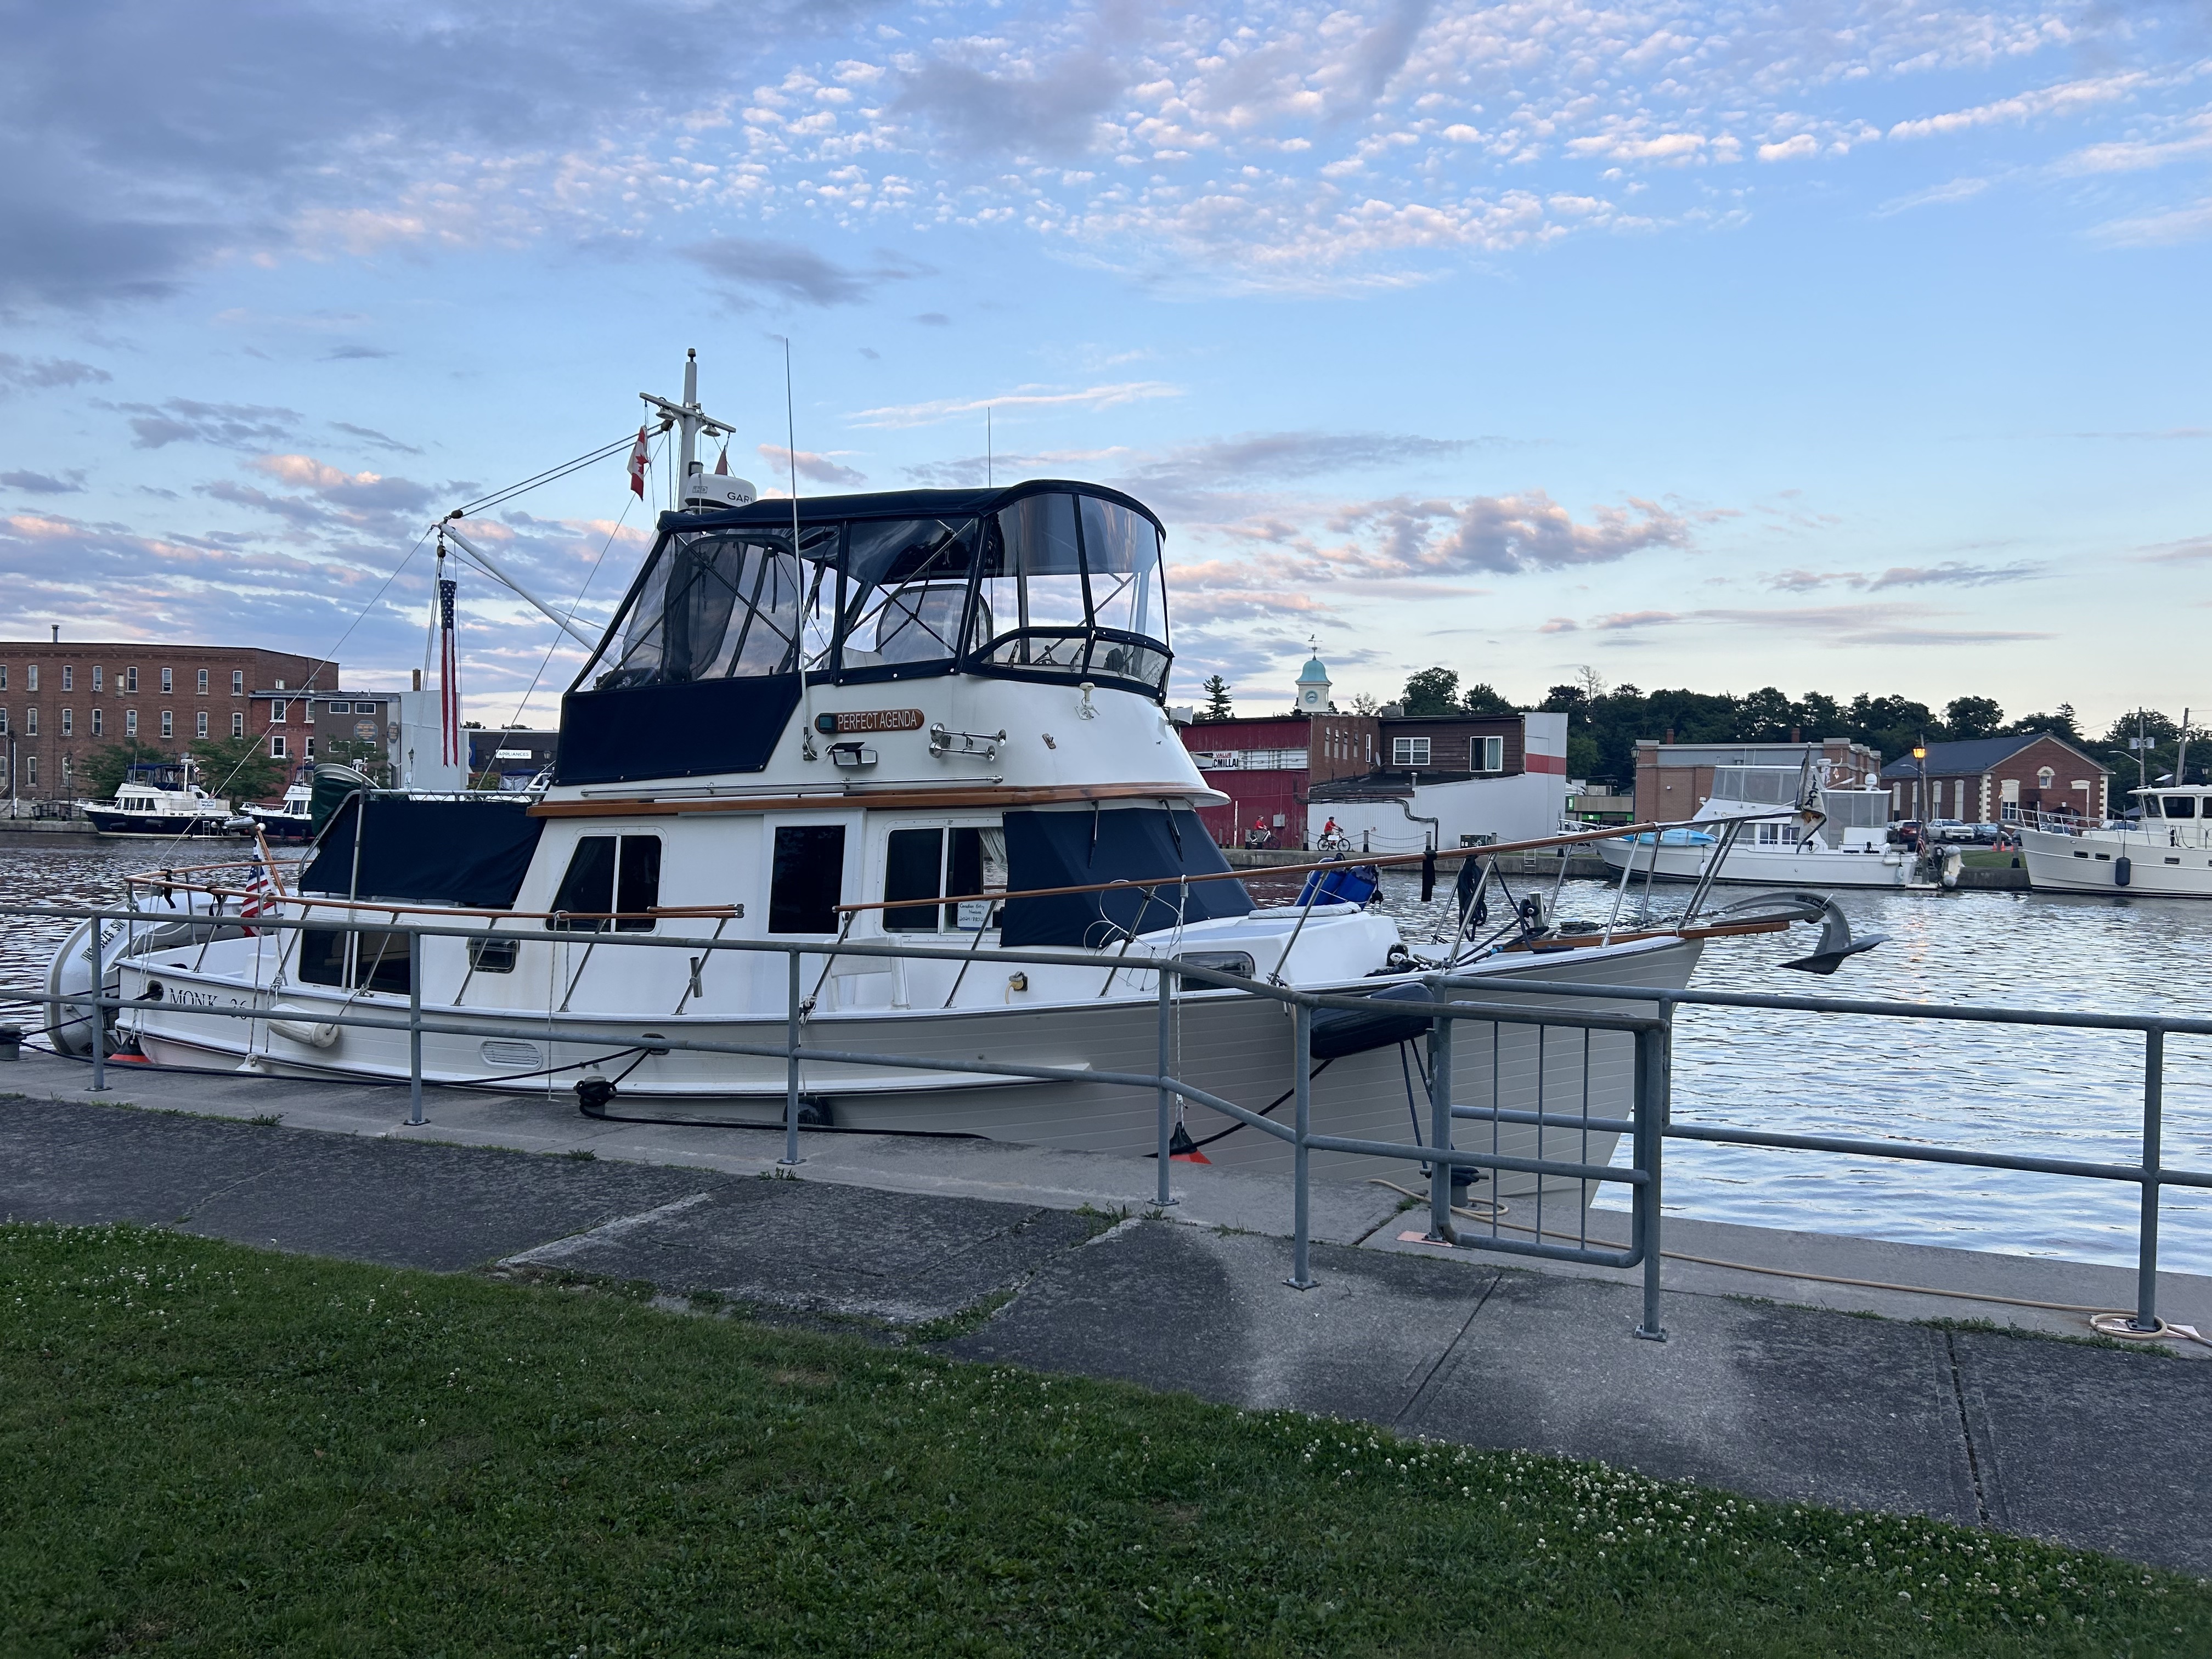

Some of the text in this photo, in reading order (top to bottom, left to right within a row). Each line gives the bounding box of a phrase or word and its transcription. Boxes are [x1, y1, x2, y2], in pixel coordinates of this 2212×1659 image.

[838, 711, 917, 730] PERFECT AGENDA
[1212, 758, 1238, 768] CMILLA
[169, 988, 218, 1006] MONK
